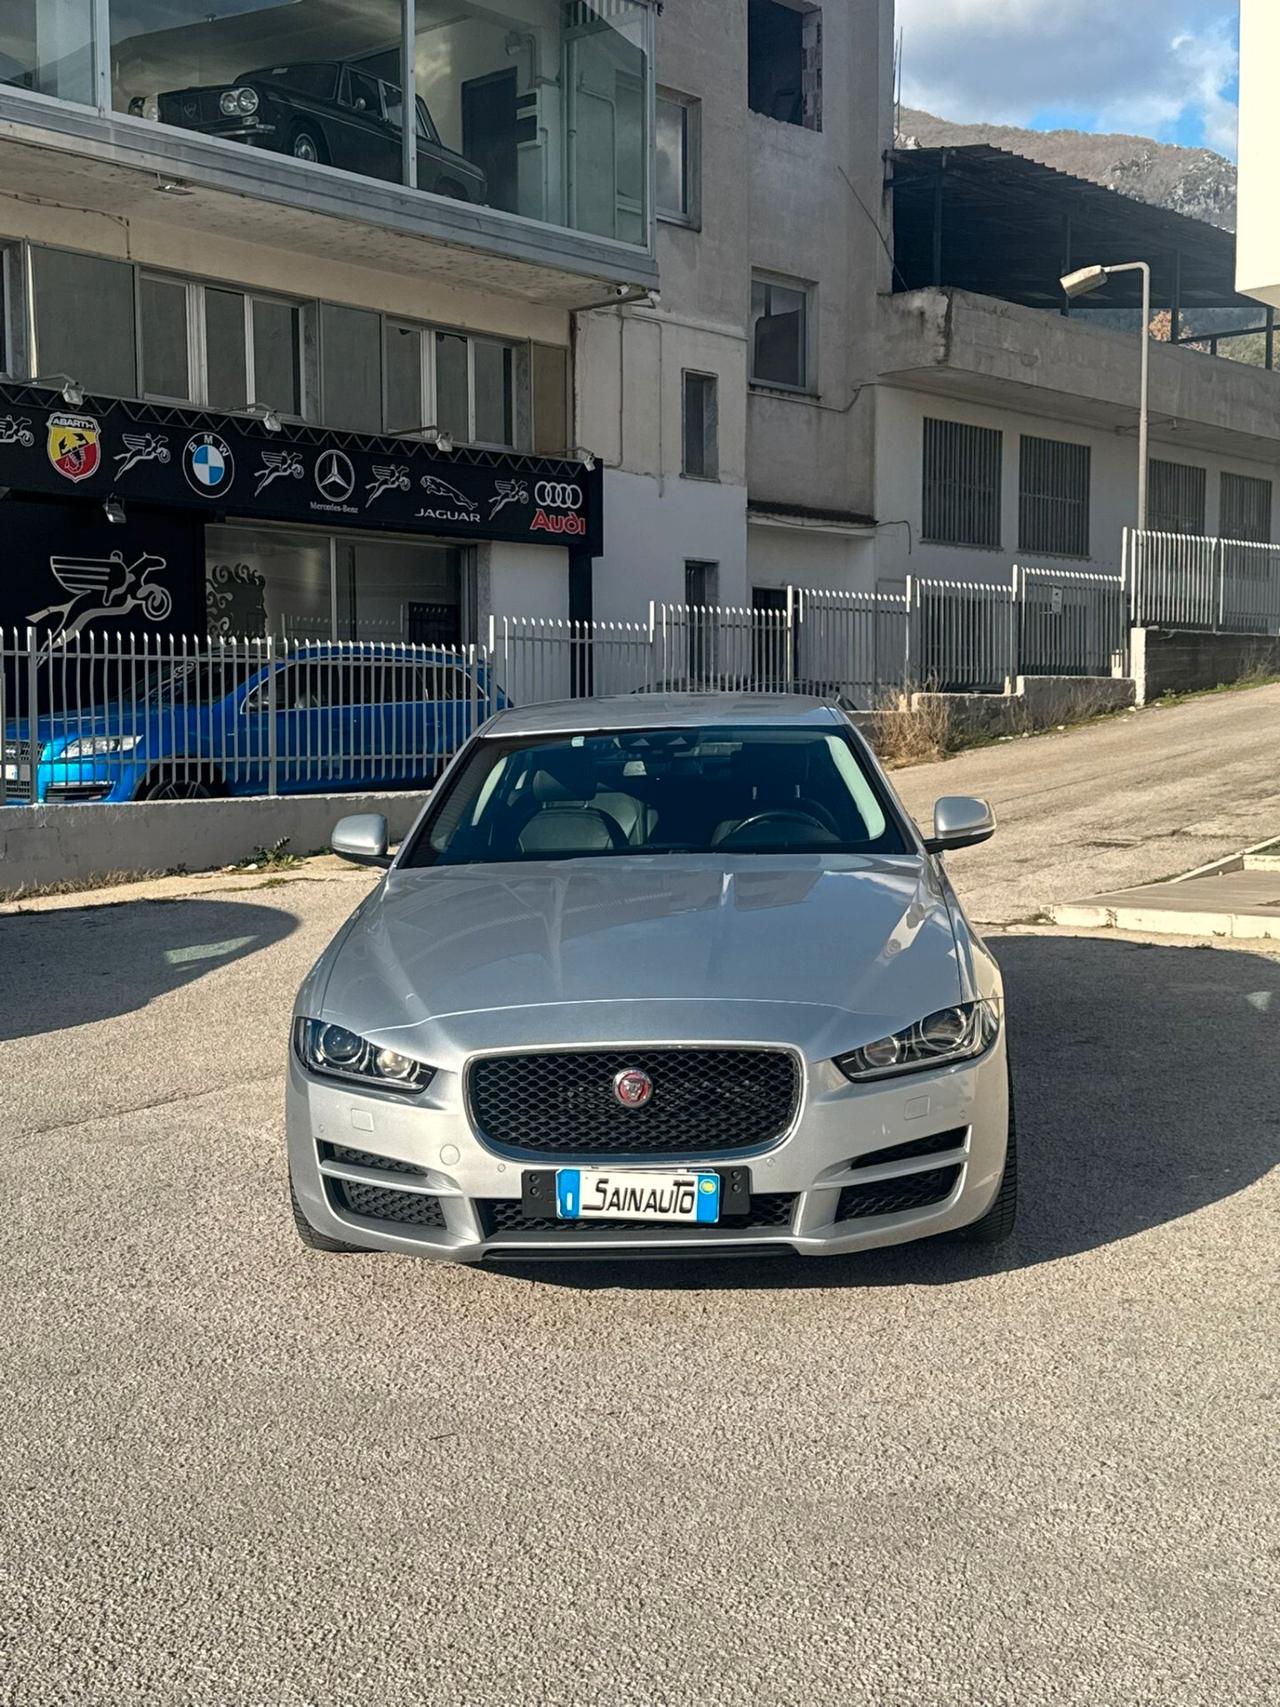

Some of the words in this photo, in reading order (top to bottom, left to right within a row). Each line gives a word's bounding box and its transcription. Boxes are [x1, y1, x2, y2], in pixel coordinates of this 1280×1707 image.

[52, 417, 94, 429] ABARTH
[188, 435, 230, 457] BMW
[309, 501, 359, 514] Mercedes-Benz
[415, 508, 481, 523] JAGUAR
